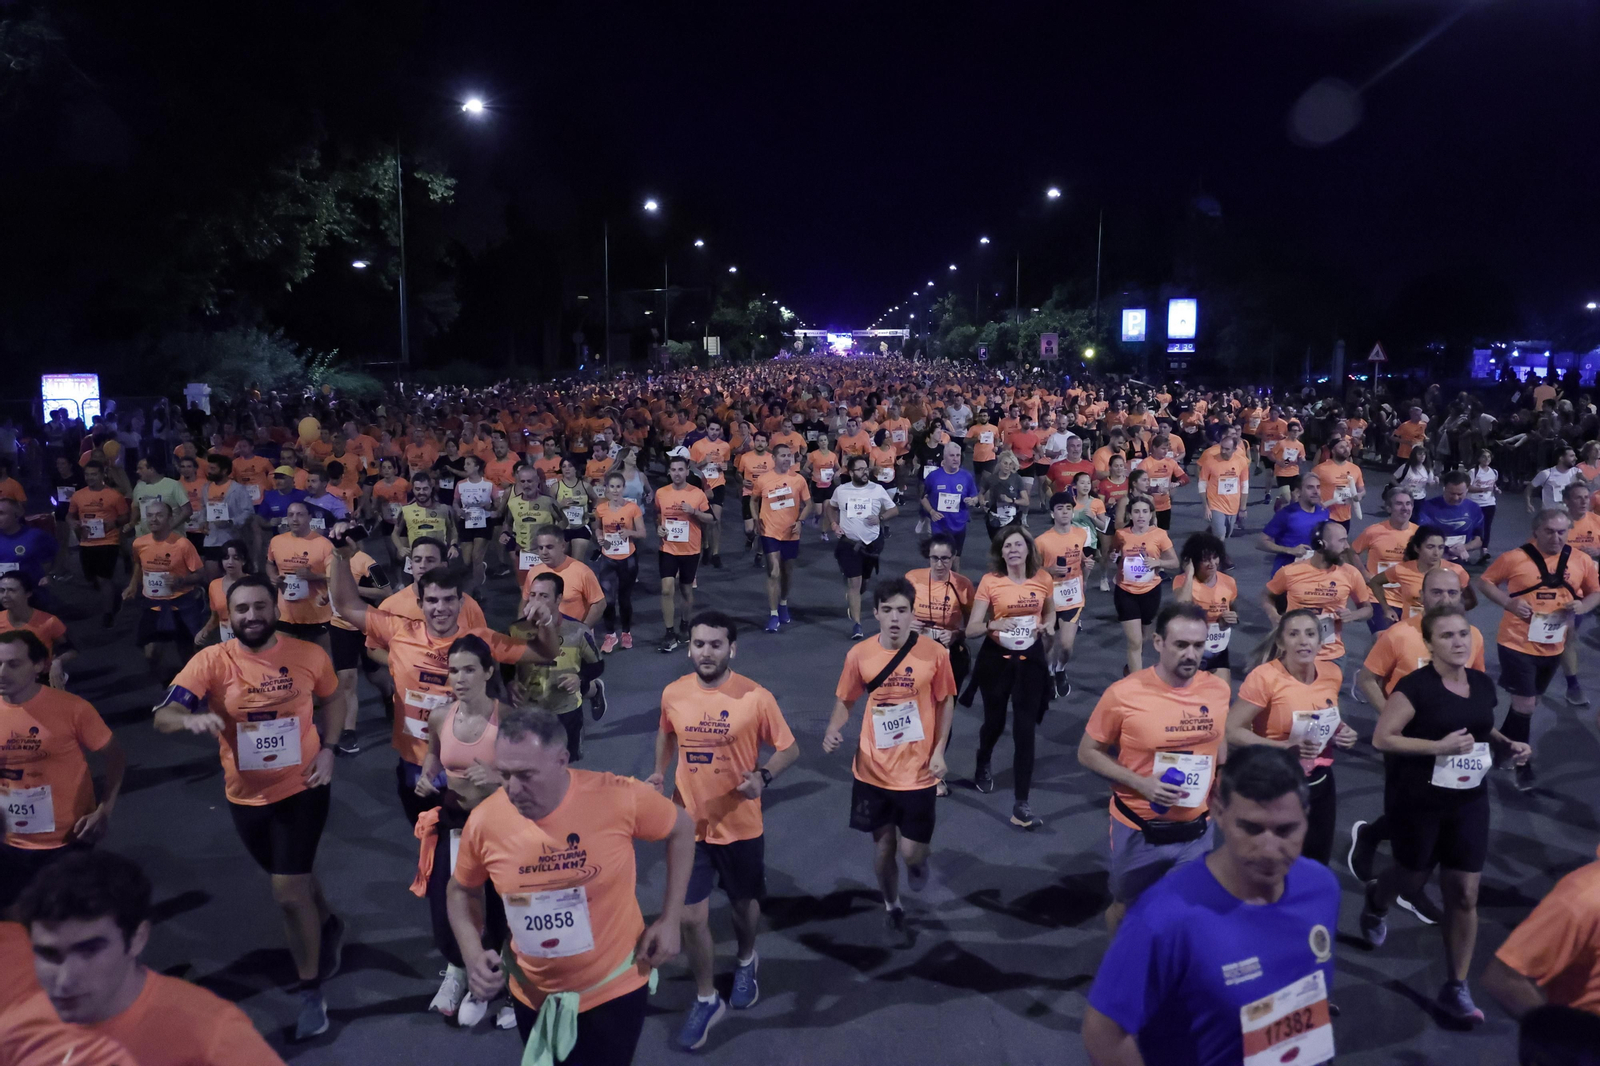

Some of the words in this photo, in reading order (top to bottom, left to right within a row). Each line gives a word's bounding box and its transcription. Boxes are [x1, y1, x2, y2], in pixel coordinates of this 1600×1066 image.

[1060, 587, 1078, 596] 10913
[261, 677, 293, 688] NOCTURNA
[277, 683, 293, 691] KH7
[882, 716, 911, 731] 10974
[256, 736, 285, 749] 8591
[1451, 758, 1482, 770] 14826
[8, 804, 36, 815] 4251
[538, 850, 587, 863] NOCTURNA
[519, 863, 560, 874] SEVILLA
[562, 858, 586, 870] KH7
[524, 911, 574, 931] 20858
[1266, 1008, 1314, 1045] 17382
